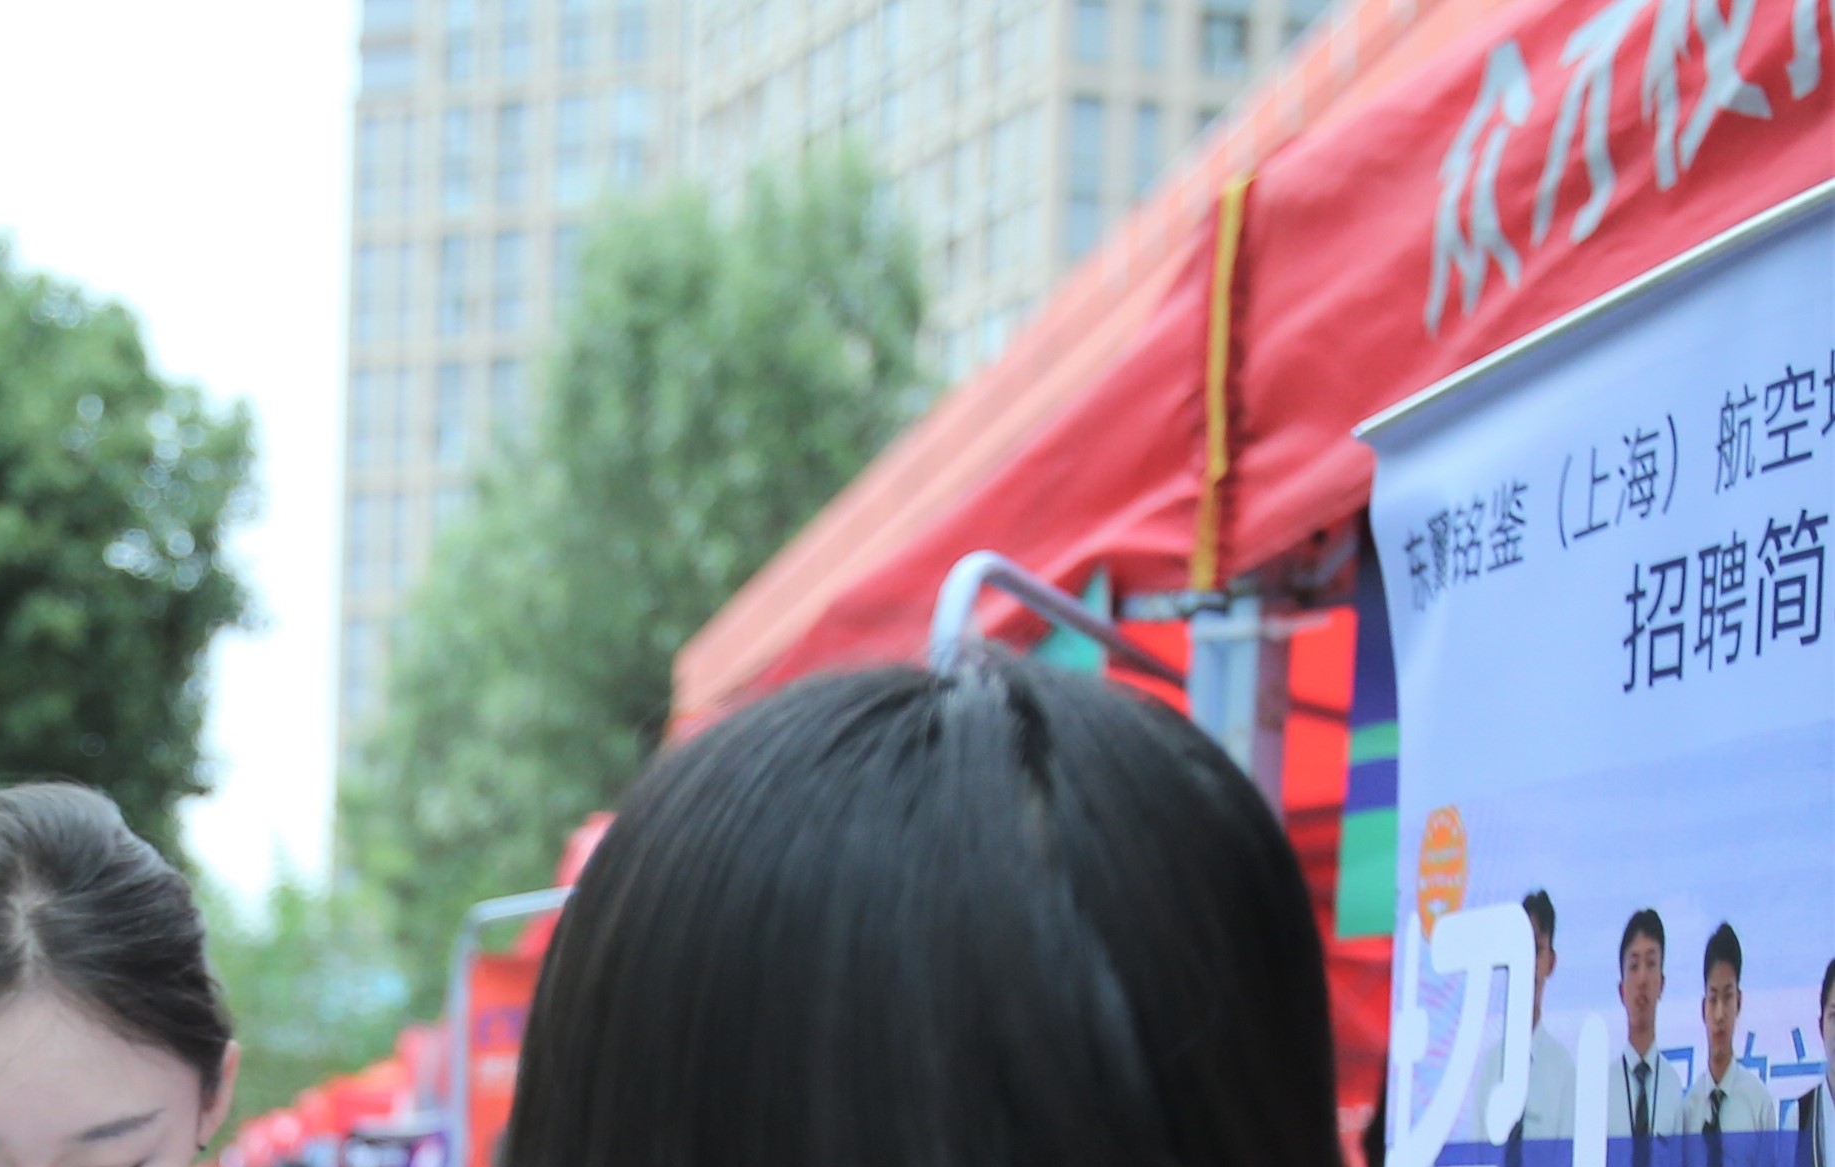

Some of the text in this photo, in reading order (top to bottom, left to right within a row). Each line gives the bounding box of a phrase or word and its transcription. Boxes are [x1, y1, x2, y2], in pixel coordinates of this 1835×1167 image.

[1404, 348, 1835, 613] 东翼铭鉴（上海）航空
